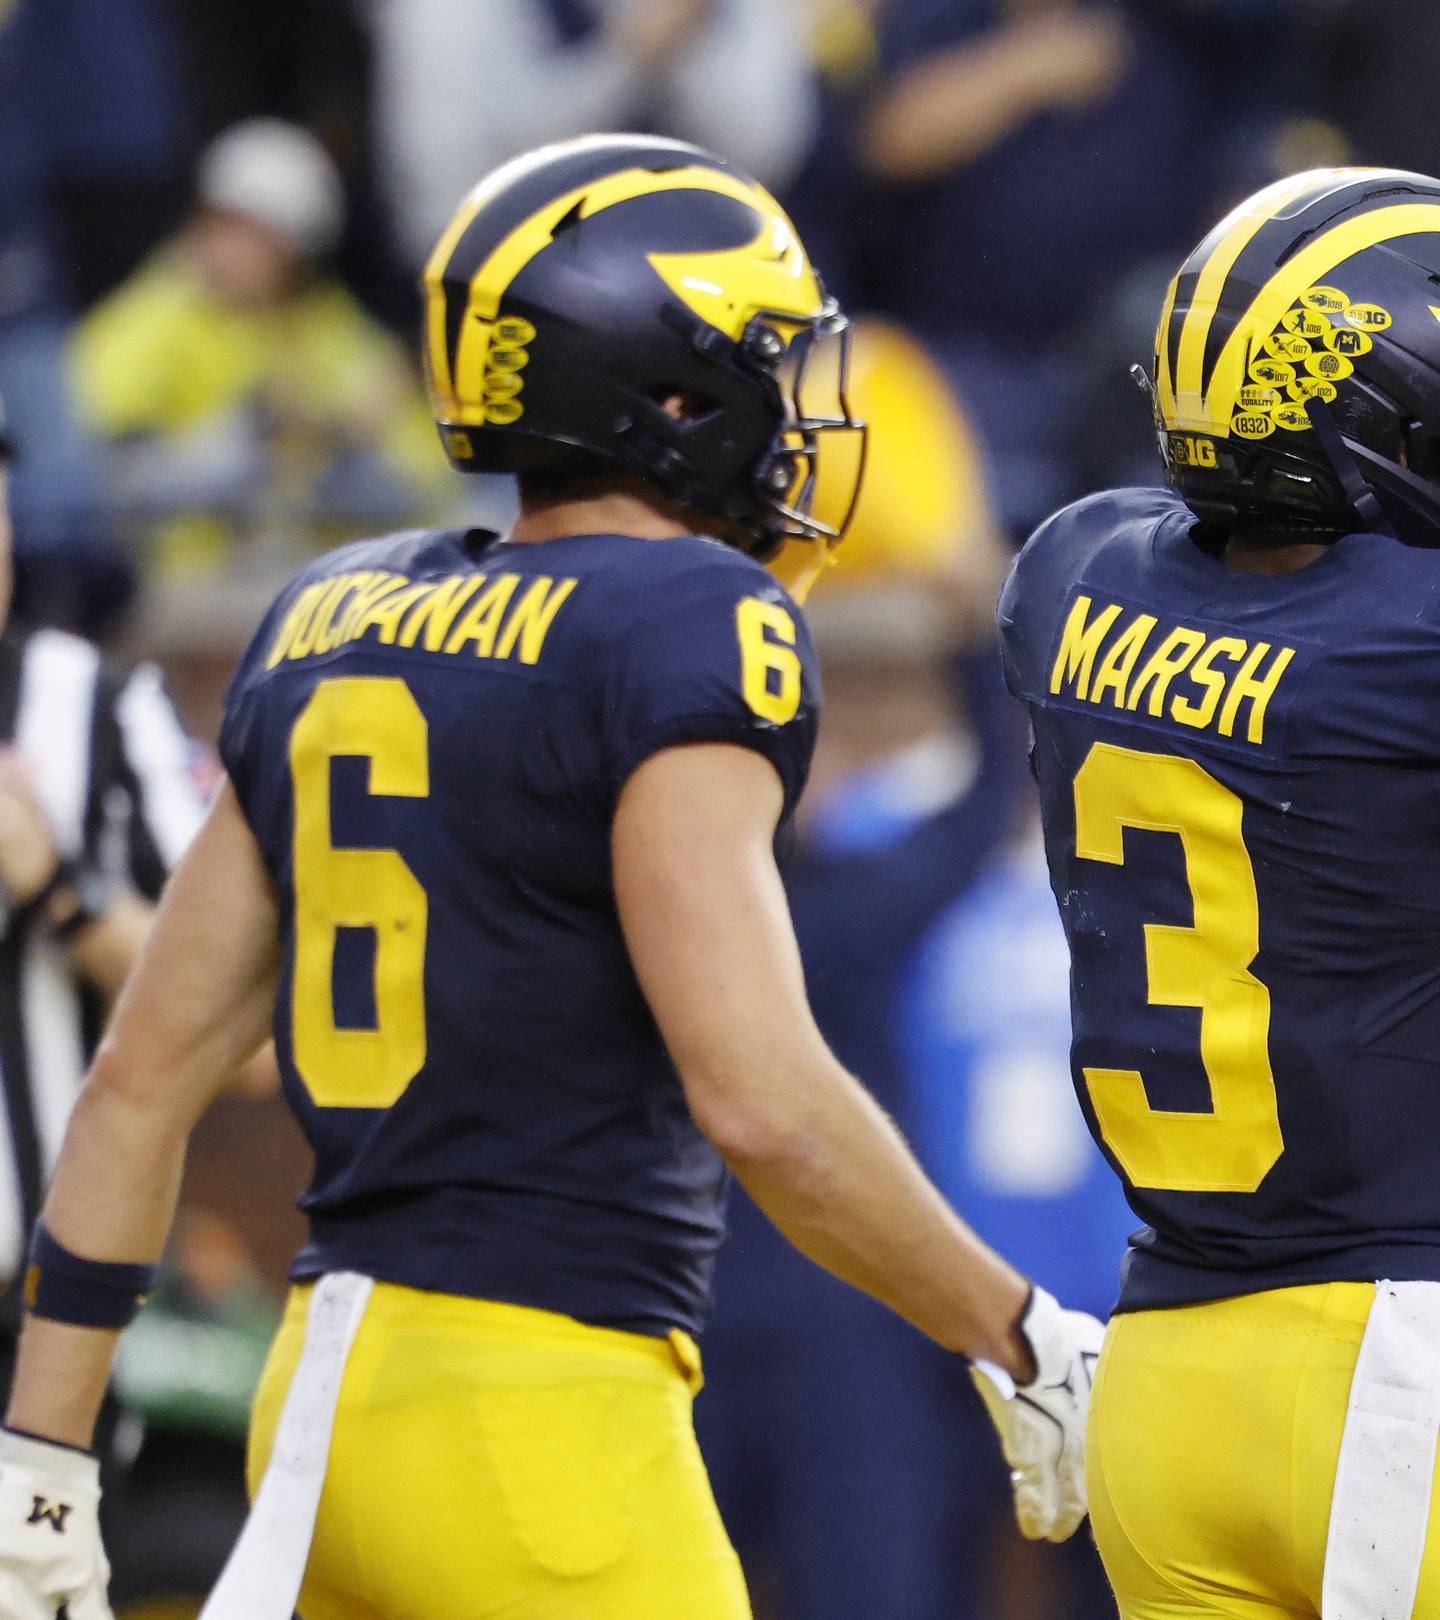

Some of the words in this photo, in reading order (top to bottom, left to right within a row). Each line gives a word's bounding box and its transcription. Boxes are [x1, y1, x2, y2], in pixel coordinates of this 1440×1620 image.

[1342, 335, 1354, 344] M
[1236, 417, 1269, 434] (832)
[1241, 398, 1274, 407] EQUALITY
[736, 596, 802, 726] 6
[1049, 595, 1297, 745] MARSH
[289, 676, 430, 1109] 6
[1073, 741, 1286, 1193] 3
[26, 1495, 74, 1533] M
